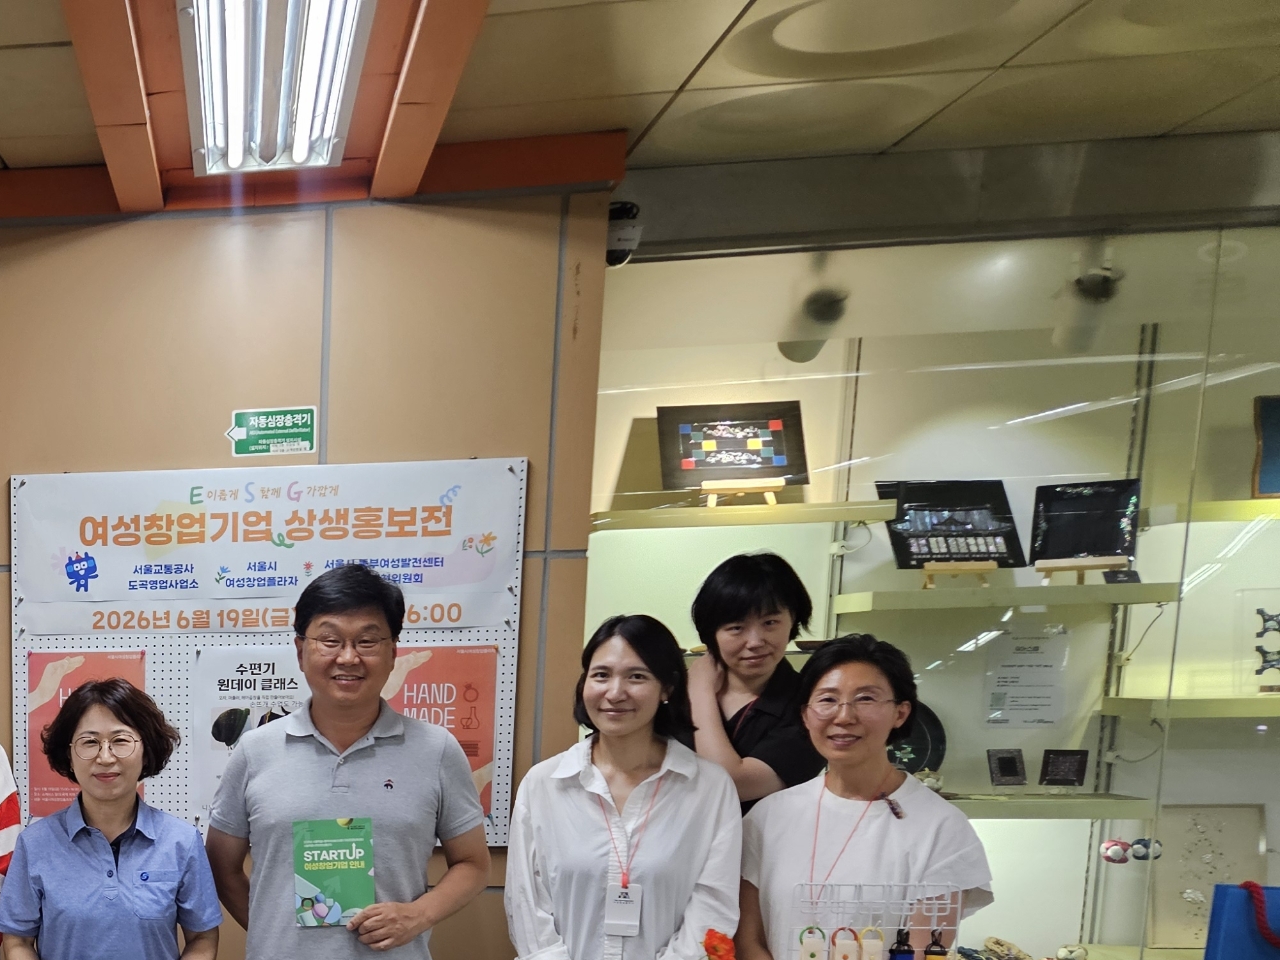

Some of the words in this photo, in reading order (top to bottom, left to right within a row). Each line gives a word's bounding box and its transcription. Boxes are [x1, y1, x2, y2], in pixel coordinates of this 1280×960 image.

[249, 413, 311, 428] 자동심장충격기
[190, 486, 204, 505] E
[207, 489, 239, 501] 이롭게
[244, 482, 255, 503] S
[260, 487, 281, 498] 함께
[287, 481, 303, 502] G
[306, 484, 339, 497] 가깝게
[79, 509, 272, 547] 여성창업기업
[285, 505, 453, 541] 상생홍보전
[133, 563, 195, 576] 서울교통공사
[246, 561, 278, 572] 서울시
[128, 579, 199, 591] 도곡영업사업소
[225, 576, 299, 588] 여성창업플라자
[92, 610, 170, 630] 2026년
[177, 609, 210, 629] 6월
[235, 662, 276, 676] 수편기
[217, 678, 257, 691] 원데이
[261, 678, 299, 690] 클래스
[403, 683, 457, 705] HAND
[303, 842, 365, 862] STARTUP
